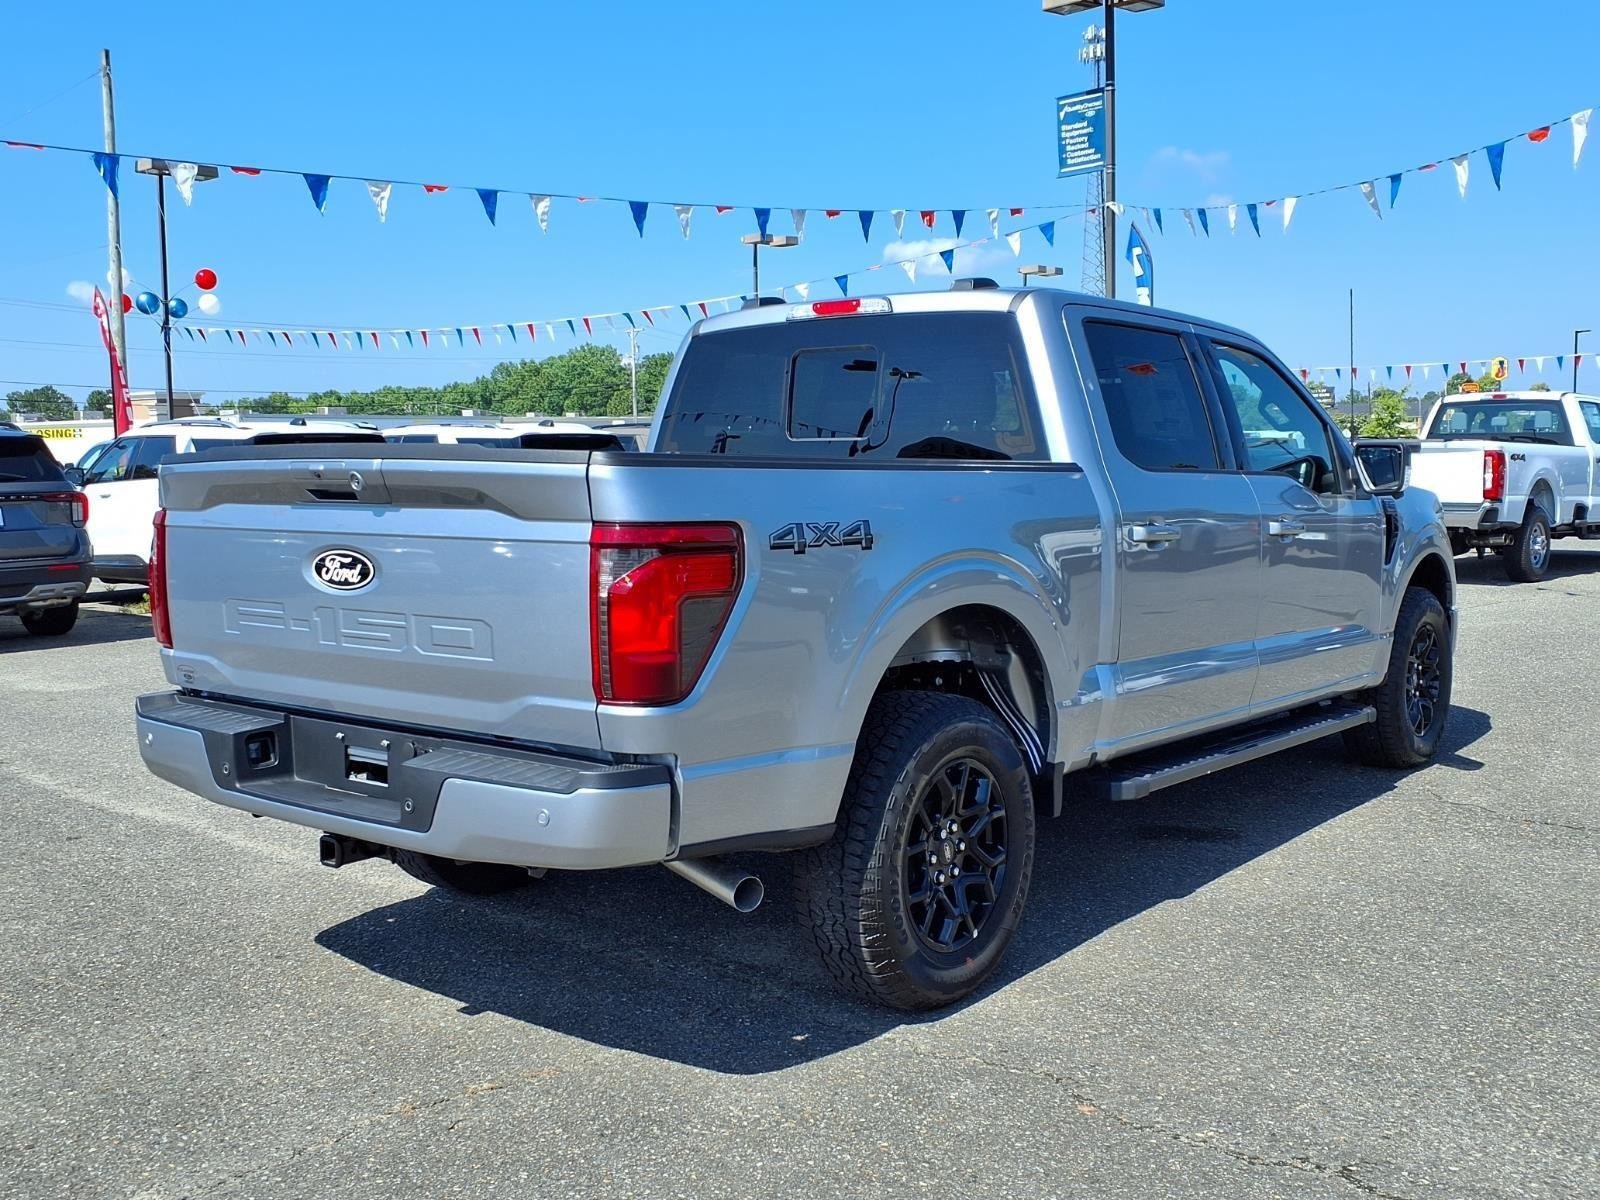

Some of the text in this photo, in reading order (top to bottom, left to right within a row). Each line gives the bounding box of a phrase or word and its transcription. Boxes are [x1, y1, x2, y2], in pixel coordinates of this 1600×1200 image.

[1061, 120, 1088, 131] Standard
[1066, 136, 1088, 145] Factory
[1066, 147, 1096, 158] Customer
[1066, 153, 1101, 165] Satisfaction
[319, 553, 364, 586] Ford
[222, 598, 495, 662] F-150
